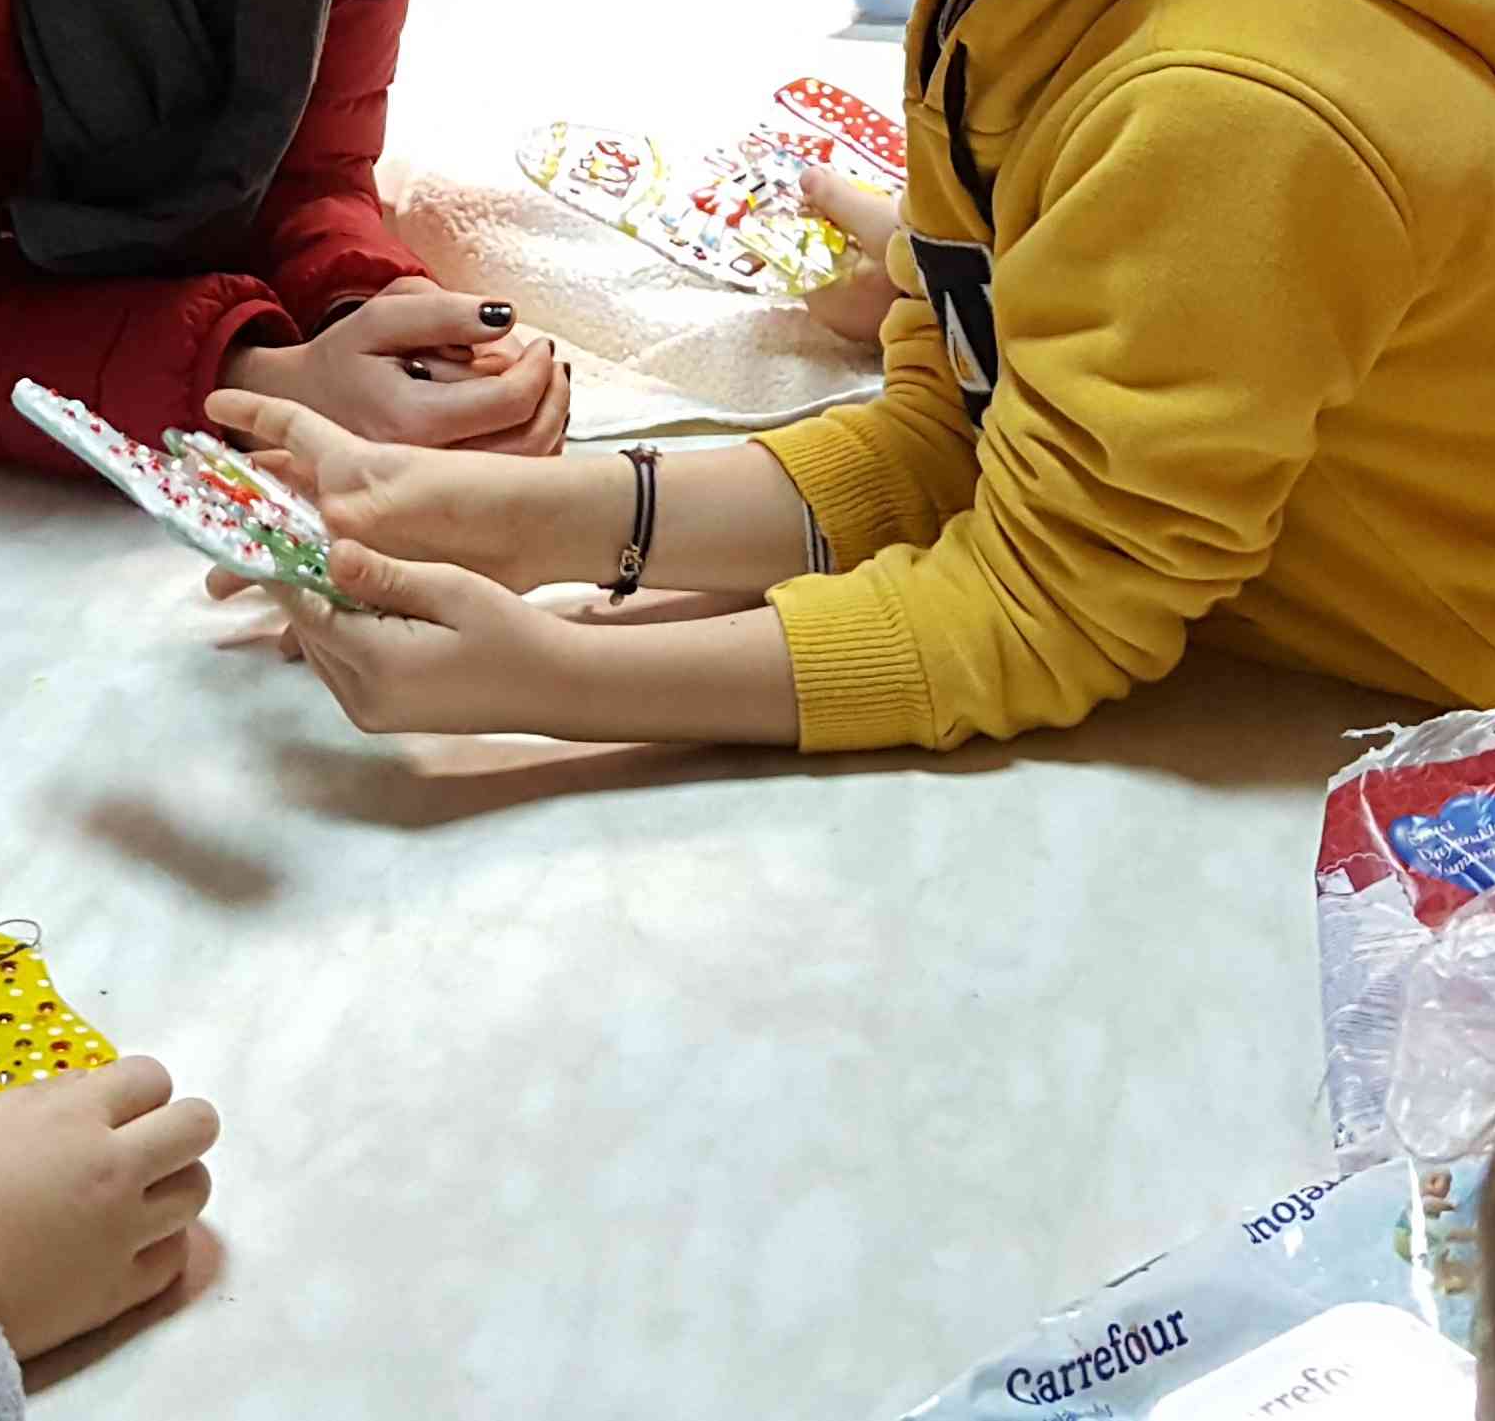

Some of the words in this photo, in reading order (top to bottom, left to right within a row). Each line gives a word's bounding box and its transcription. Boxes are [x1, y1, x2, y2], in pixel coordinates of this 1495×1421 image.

[1241, 1172, 1354, 1245] refour
[1006, 1309, 1189, 1406] Carrefour
[1244, 1363, 1355, 1417] rrefo
